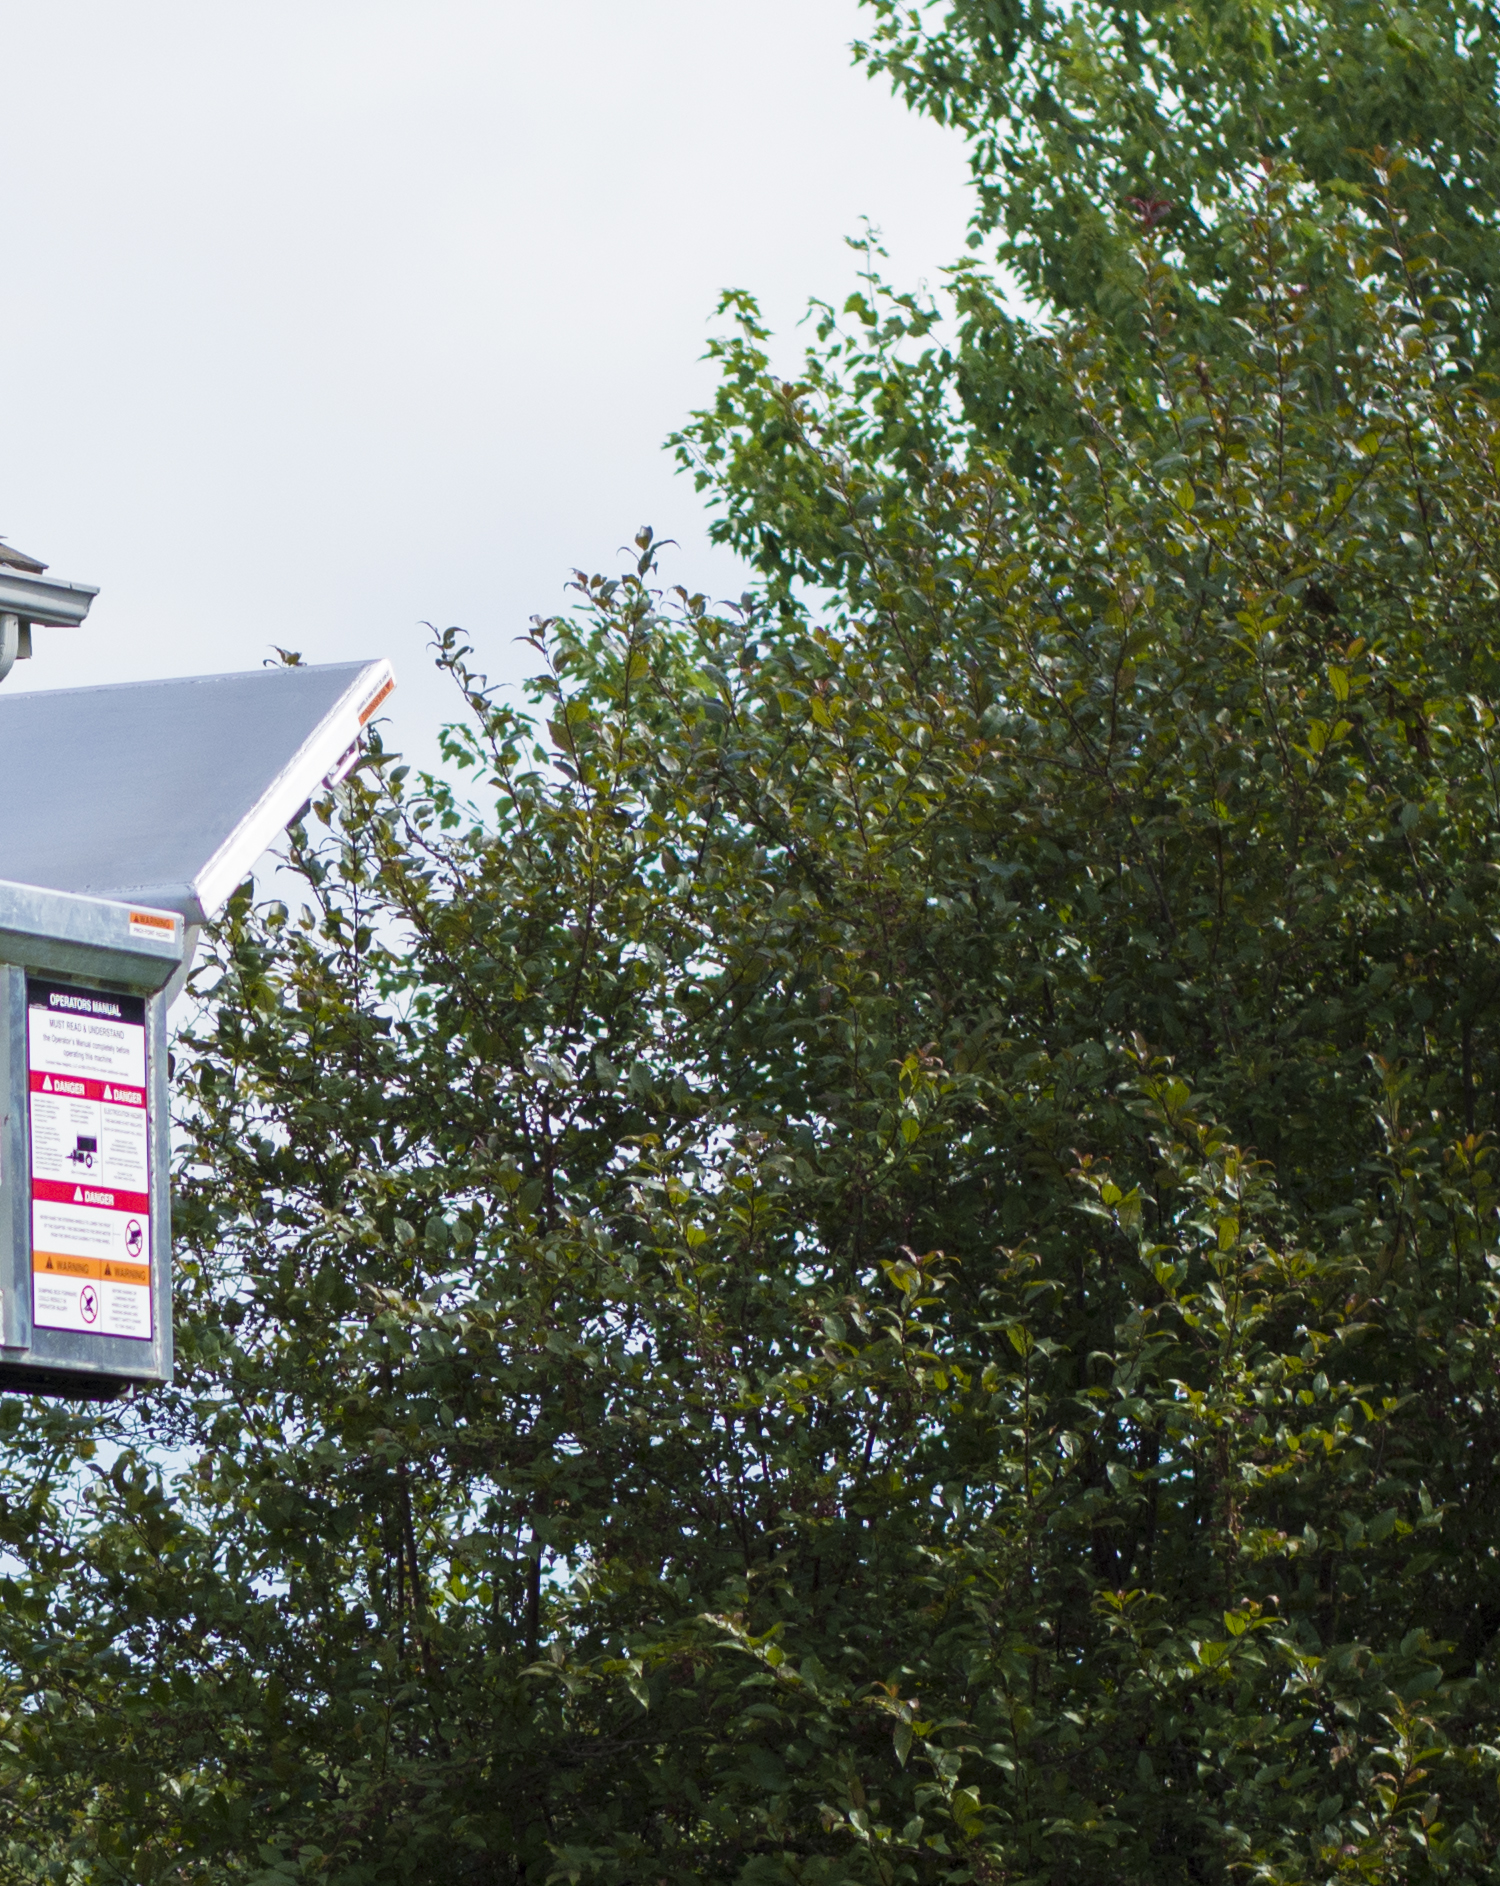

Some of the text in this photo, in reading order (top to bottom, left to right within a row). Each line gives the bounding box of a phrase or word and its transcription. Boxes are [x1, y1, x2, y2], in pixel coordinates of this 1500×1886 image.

[49, 992, 92, 1012] OPERATORS
[49, 1018, 65, 1030] MUST
[66, 1021, 82, 1033] READ
[88, 1025, 125, 1040] UNDERSTAND
[53, 1080, 86, 1095] DANGER
[113, 1089, 143, 1104] DANGER
[84, 1190, 115, 1206] DANGER
[56, 1260, 90, 1275] WARNING
[114, 1267, 146, 1281] WARNING
